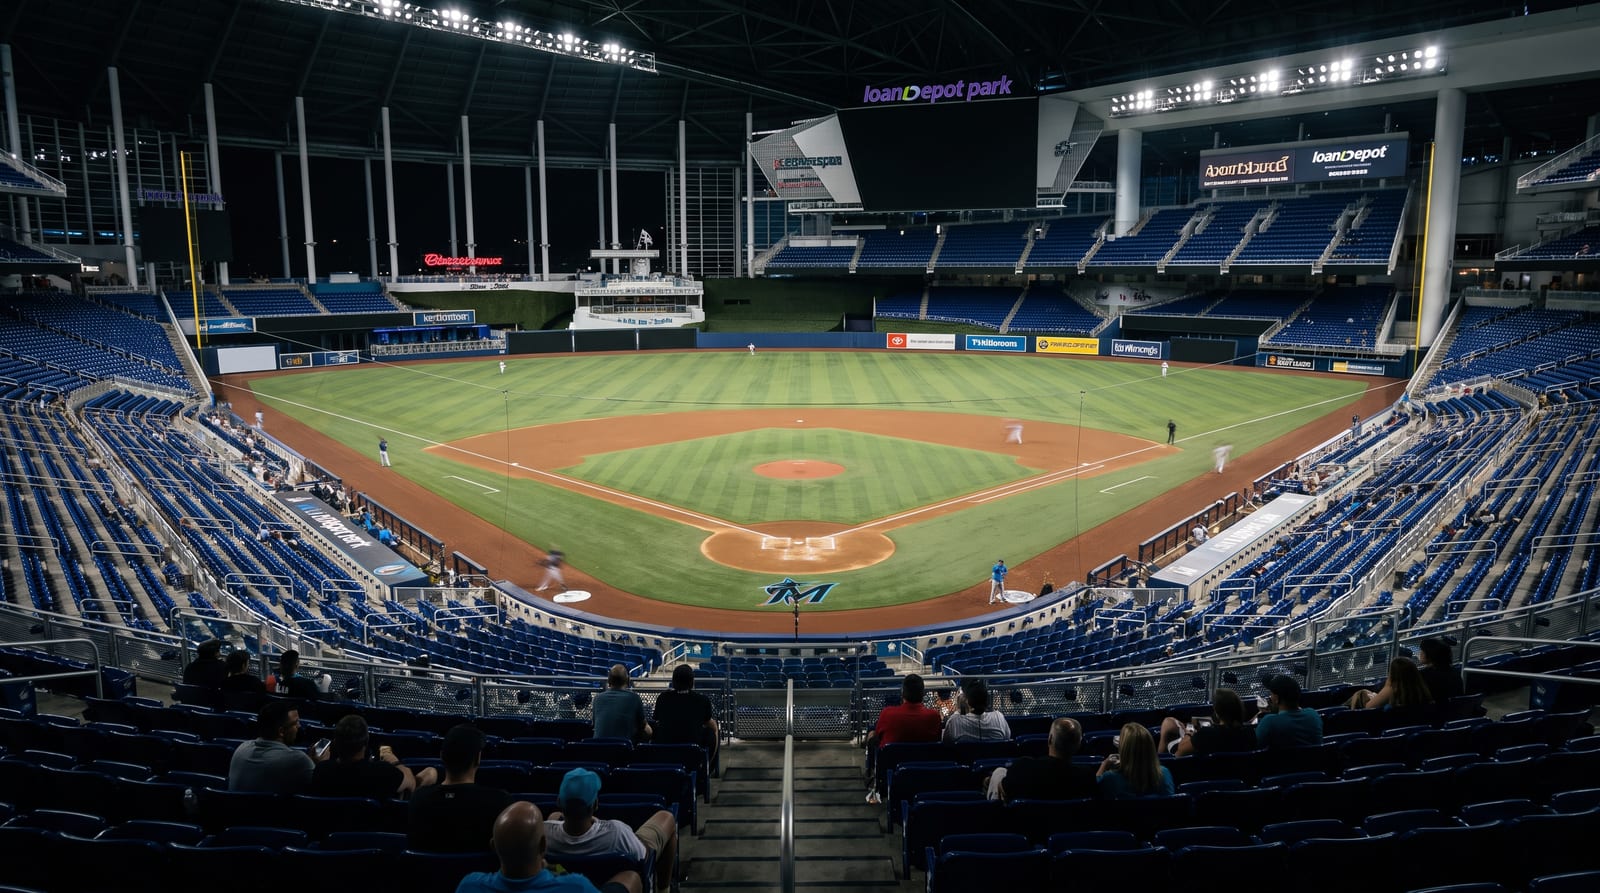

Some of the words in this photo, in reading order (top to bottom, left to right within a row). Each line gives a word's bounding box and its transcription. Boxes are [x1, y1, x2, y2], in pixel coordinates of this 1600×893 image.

[863, 79, 965, 103] loanDepot
[970, 74, 1014, 103] park
[1311, 144, 1388, 164] loanDepot
